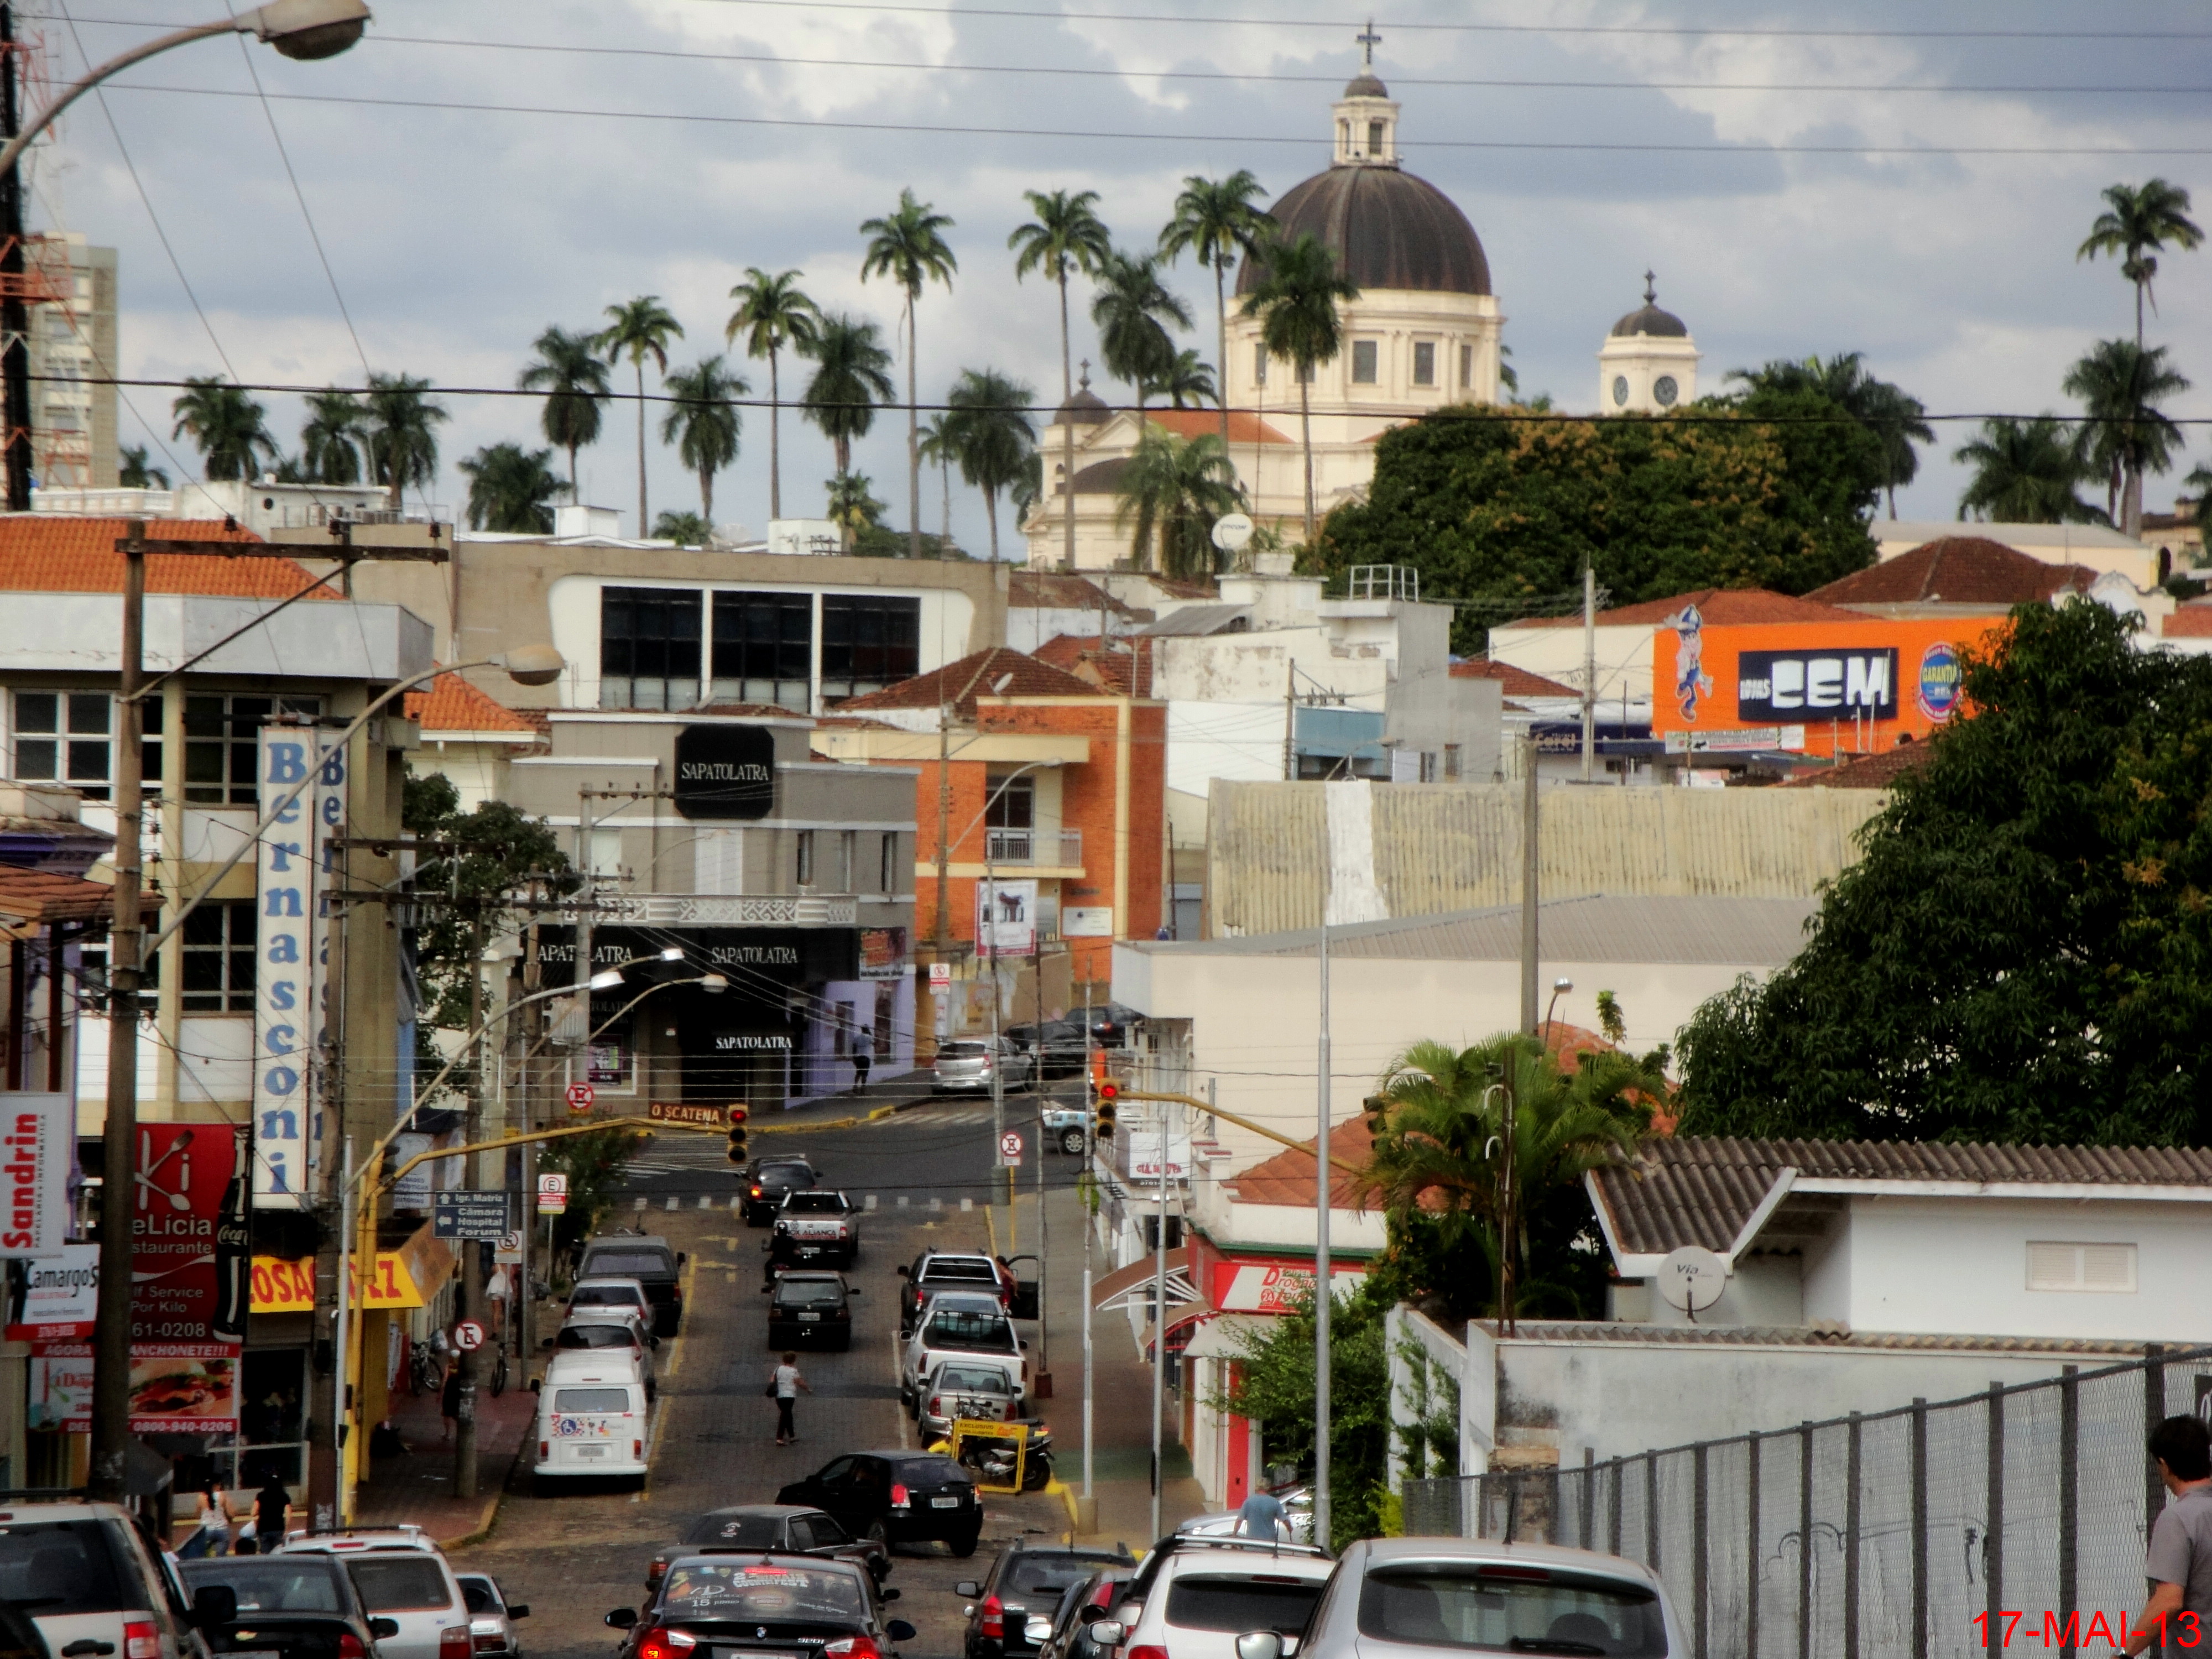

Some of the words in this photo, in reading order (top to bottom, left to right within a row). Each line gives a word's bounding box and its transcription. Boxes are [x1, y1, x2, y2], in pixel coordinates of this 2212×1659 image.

[1772, 656, 1889, 708] CEM
[681, 763, 769, 780] SAPATOLATRA
[538, 945, 632, 962] APATATRA
[712, 947, 798, 963] SAPATOLATRA
[260, 743, 307, 1193] Bernasconi
[716, 1036, 792, 1048] SAPATOLATRA
[652, 1104, 661, 1116] O
[665, 1106, 719, 1122] SCATENA
[2, 1114, 37, 1248] Sandrin
[455, 1193, 470, 1203] Igr.
[473, 1193, 503, 1202] Matriz
[457, 1207, 503, 1215] Câmara
[133, 1214, 211, 1235] eLícia
[457, 1218, 502, 1227] Hospital
[132, 1241, 212, 1254] staurante
[1677, 1265, 1698, 1274] Via
[149, 1286, 204, 1298] Service
[131, 1301, 155, 1312] Por
[159, 1301, 187, 1313] Kilo
[132, 1322, 206, 1337] 61-0208
[44, 1344, 92, 1355] AGORA
[129, 1345, 229, 1357] ANCHONETE!!!
